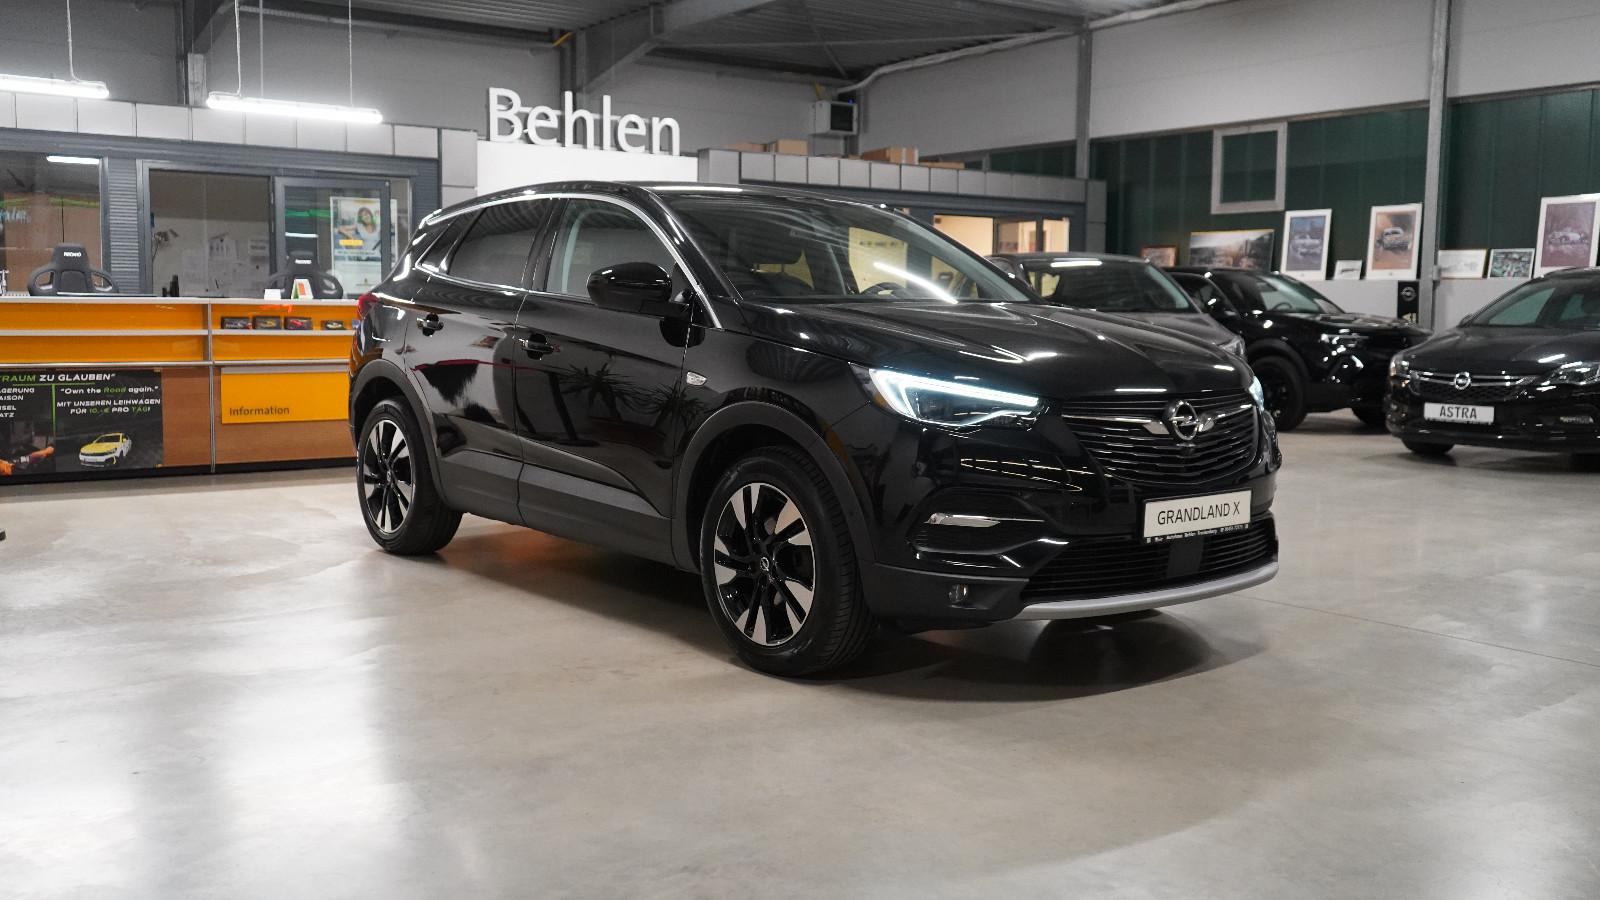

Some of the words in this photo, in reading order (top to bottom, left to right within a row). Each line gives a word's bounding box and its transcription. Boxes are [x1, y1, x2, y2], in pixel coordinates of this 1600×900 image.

[489, 87, 680, 156] Behlen
[0, 374, 36, 382] RAUM
[39, 374, 55, 382] ZU
[113, 398, 160, 406] LEIHWAGEN
[229, 405, 290, 416] Information
[1440, 405, 1477, 419] ASTRA
[1157, 503, 1231, 525] GRANDLAND
[1233, 501, 1241, 516] X
